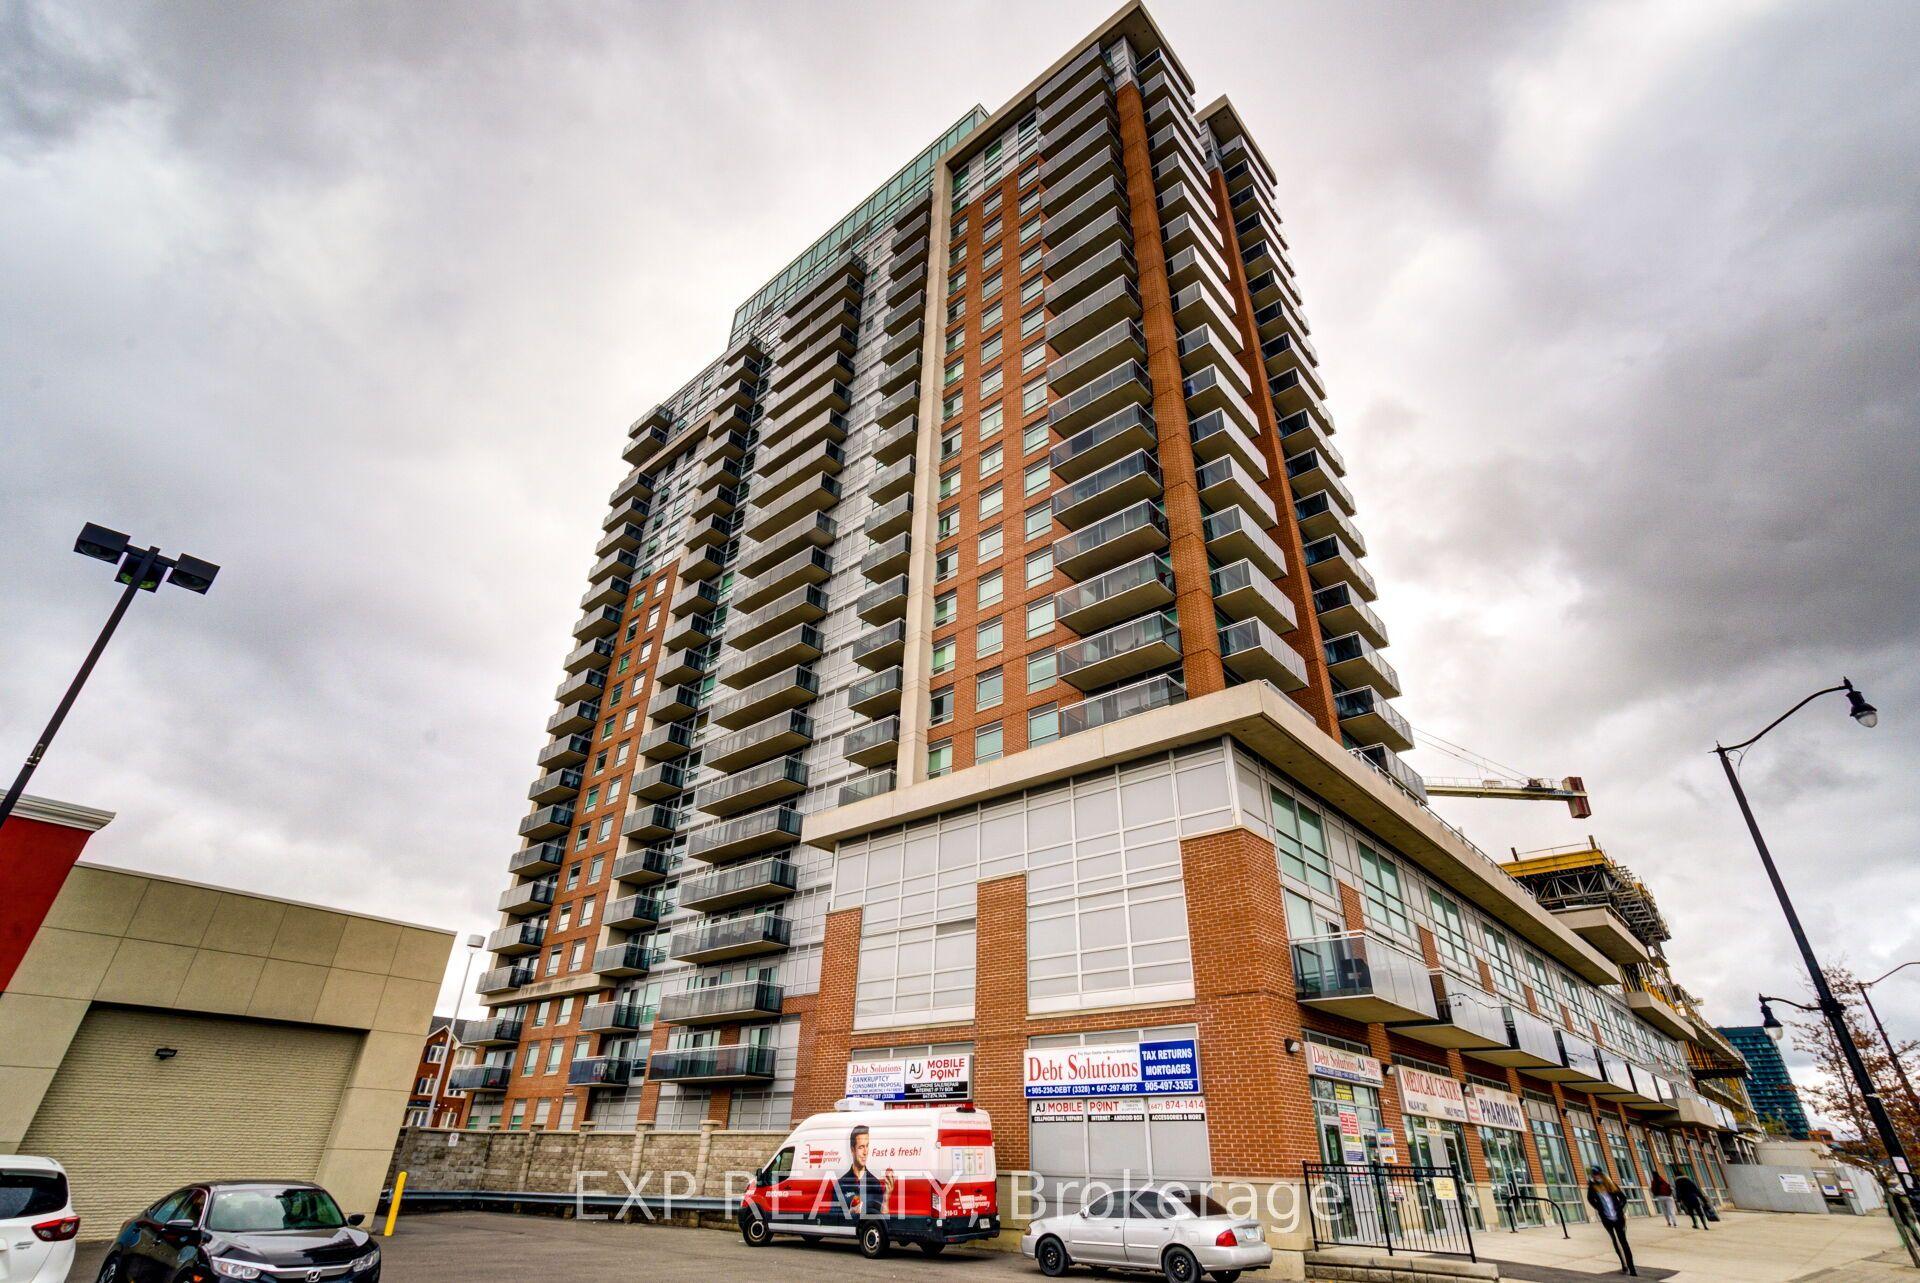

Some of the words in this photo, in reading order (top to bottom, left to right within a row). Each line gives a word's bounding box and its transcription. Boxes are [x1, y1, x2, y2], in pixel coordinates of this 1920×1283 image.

[1142, 1050, 1156, 1060] TAX
[1158, 1048, 1192, 1059] RETURNS
[852, 1064, 867, 1074] Debt
[870, 1063, 901, 1073] Solutions
[909, 1063, 921, 1074] AJ
[927, 1058, 965, 1069] MOBILE
[1028, 1057, 1063, 1081] Debt
[1068, 1054, 1138, 1080] Solutions
[930, 1069, 961, 1080] POINT
[1145, 1064, 1191, 1075] MORTGAGES
[852, 1075, 889, 1083] BANKRUPTCY
[1032, 1086, 1071, 1094] 905-230-DEBT
[1072, 1085, 1090, 1094] (3328)
[1096, 1084, 1137, 1092] 647-297-9872
[1145, 1080, 1193, 1091] 905-497-3355
[1402, 1070, 1436, 1096] MEDICAL
[1435, 1078, 1462, 1101] CENTRE
[1036, 1103, 1046, 1113] AJ
[1048, 1102, 1083, 1112] MOBILE
[1089, 1101, 1119, 1113] POINT
[1165, 1100, 1205, 1109] 874-1414
[1479, 1098, 1523, 1129] PHARMACY
[872, 1148, 888, 1157] Fast
[890, 1148, 895, 1156] &
[898, 1147, 922, 1157] fresh!
